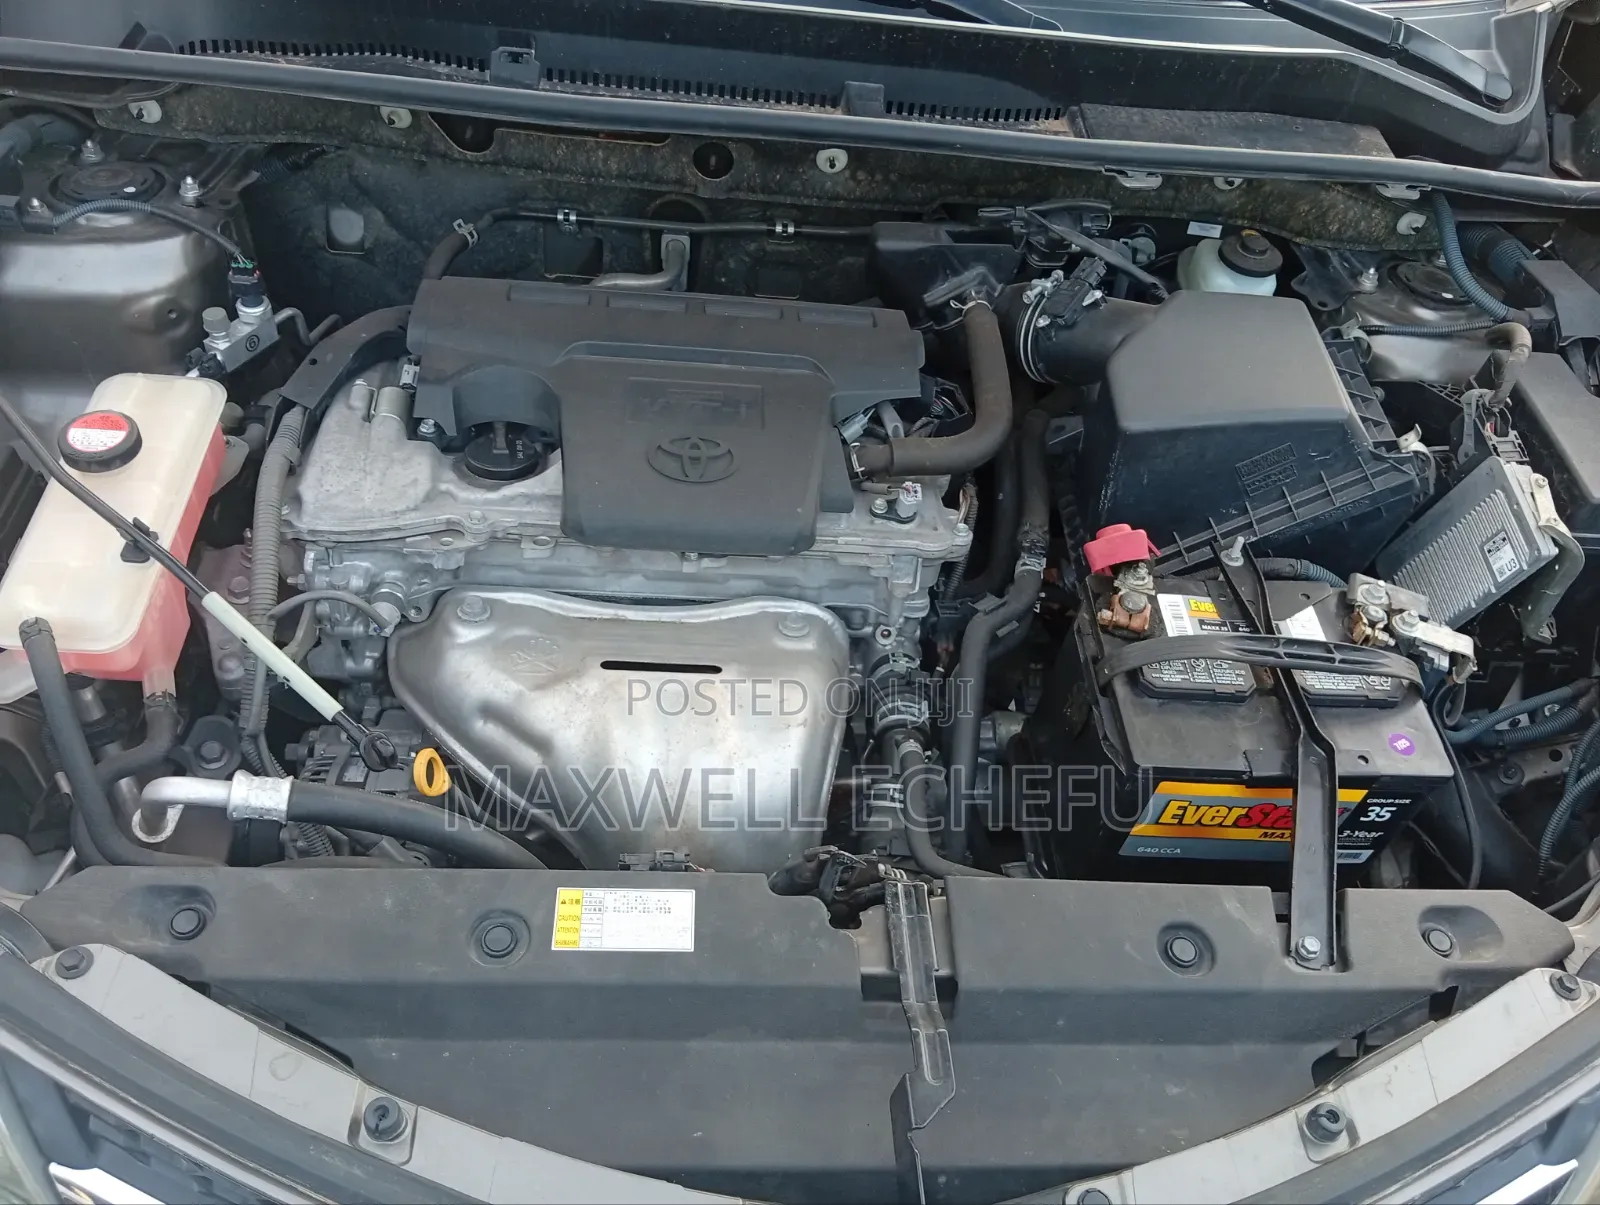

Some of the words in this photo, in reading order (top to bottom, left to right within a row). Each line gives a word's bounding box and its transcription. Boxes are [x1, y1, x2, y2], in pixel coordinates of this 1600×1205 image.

[1505, 558, 1517, 572] U3
[1359, 806, 1397, 822] 35
[1338, 830, 1384, 838] 3-Year
[558, 914, 580, 922] CAUTION
[556, 926, 580, 934] ATTENTION
